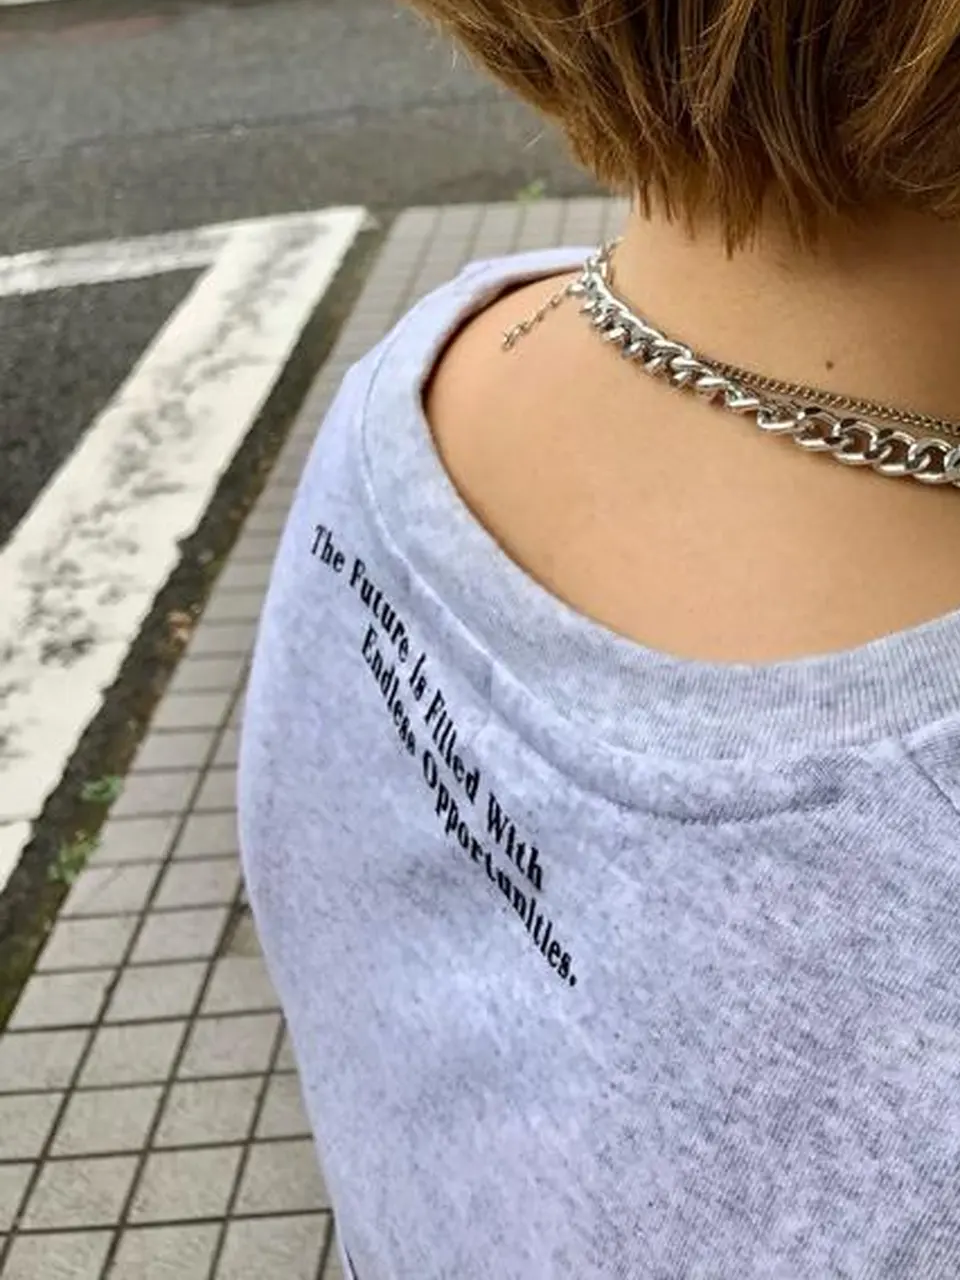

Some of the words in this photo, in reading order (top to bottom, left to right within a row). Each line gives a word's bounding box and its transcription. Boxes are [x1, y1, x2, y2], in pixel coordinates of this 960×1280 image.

[311, 524, 346, 573] The
[349, 557, 409, 664] Future
[408, 651, 429, 702] Is
[424, 688, 481, 805] Filled
[486, 791, 544, 892] With
[361, 622, 416, 756] Endless
[422, 748, 577, 987] Opportunities.
